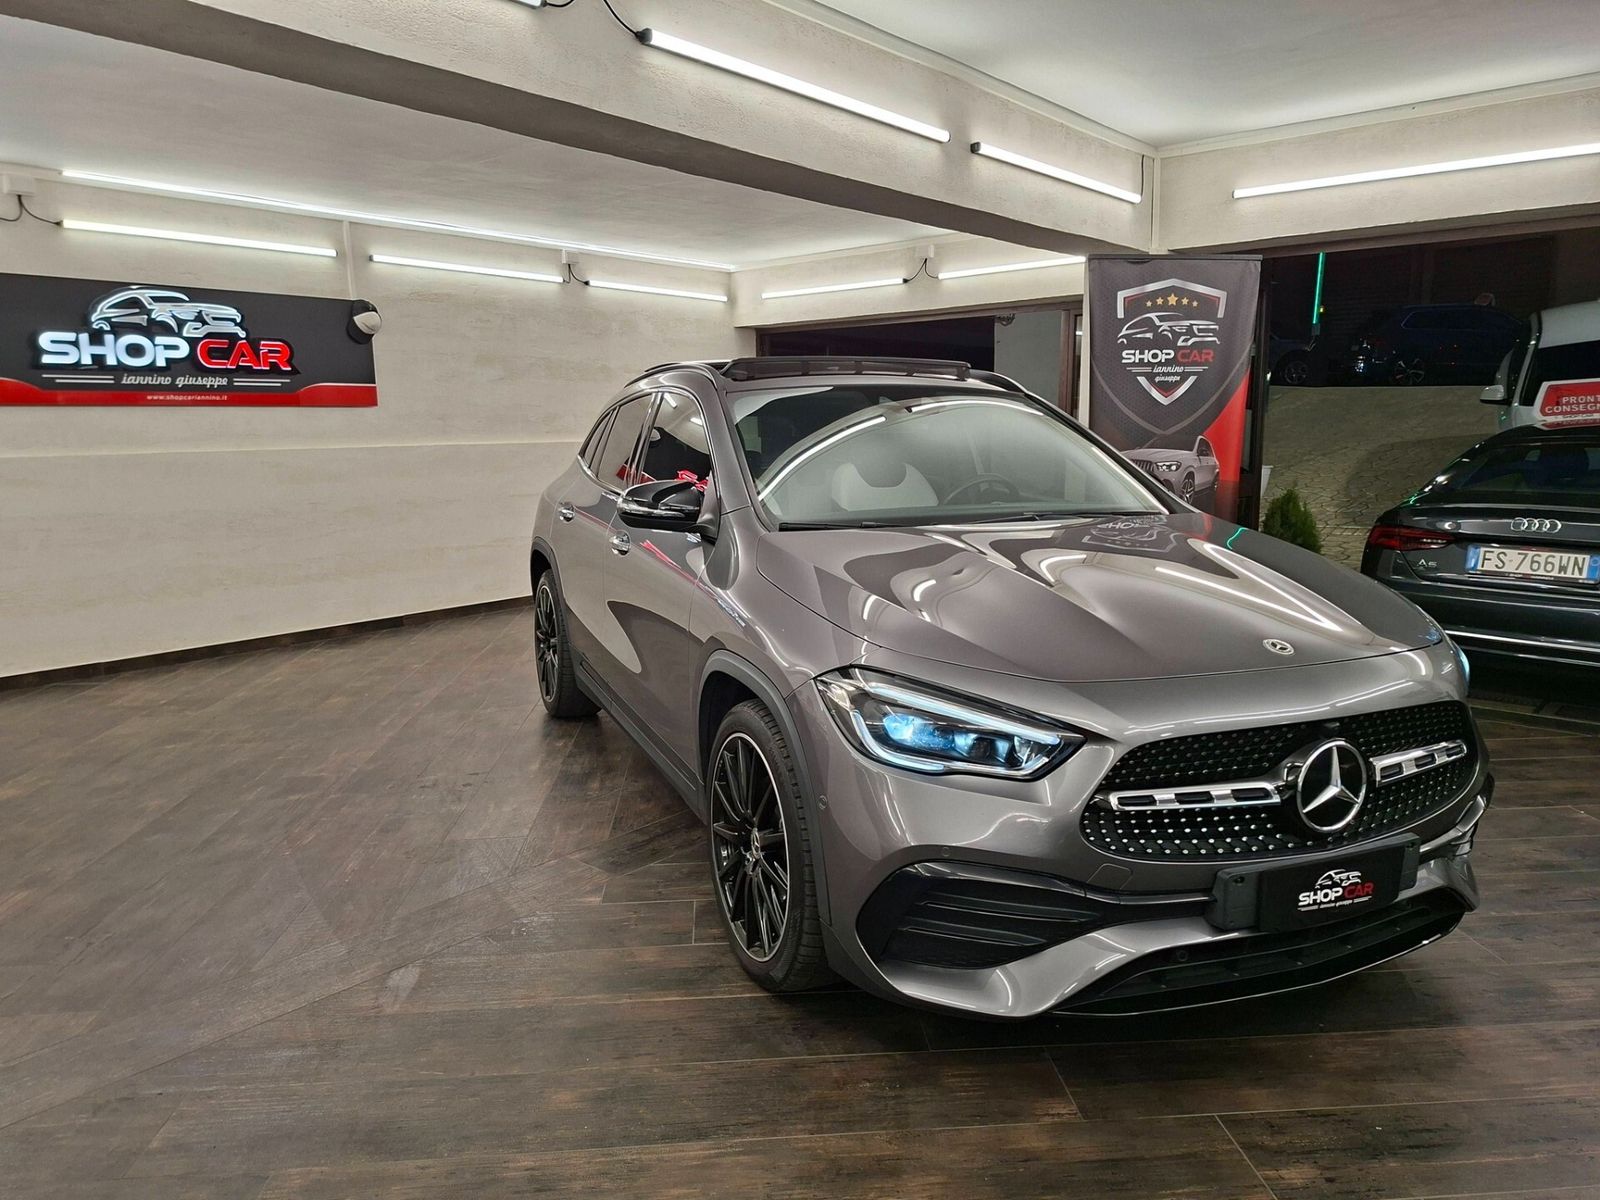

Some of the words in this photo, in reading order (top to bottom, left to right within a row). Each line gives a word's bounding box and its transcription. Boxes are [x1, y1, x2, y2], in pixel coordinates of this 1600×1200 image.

[38, 331, 190, 367] SHOP
[197, 338, 292, 370] CAR
[1121, 349, 1175, 363] SHOP
[1177, 350, 1213, 362] CAR
[1152, 364, 1184, 373] iannino
[121, 373, 172, 385] iannino
[175, 375, 228, 388] giuseppe
[1298, 887, 1343, 906] SHOP
[1344, 882, 1374, 899] CAR
